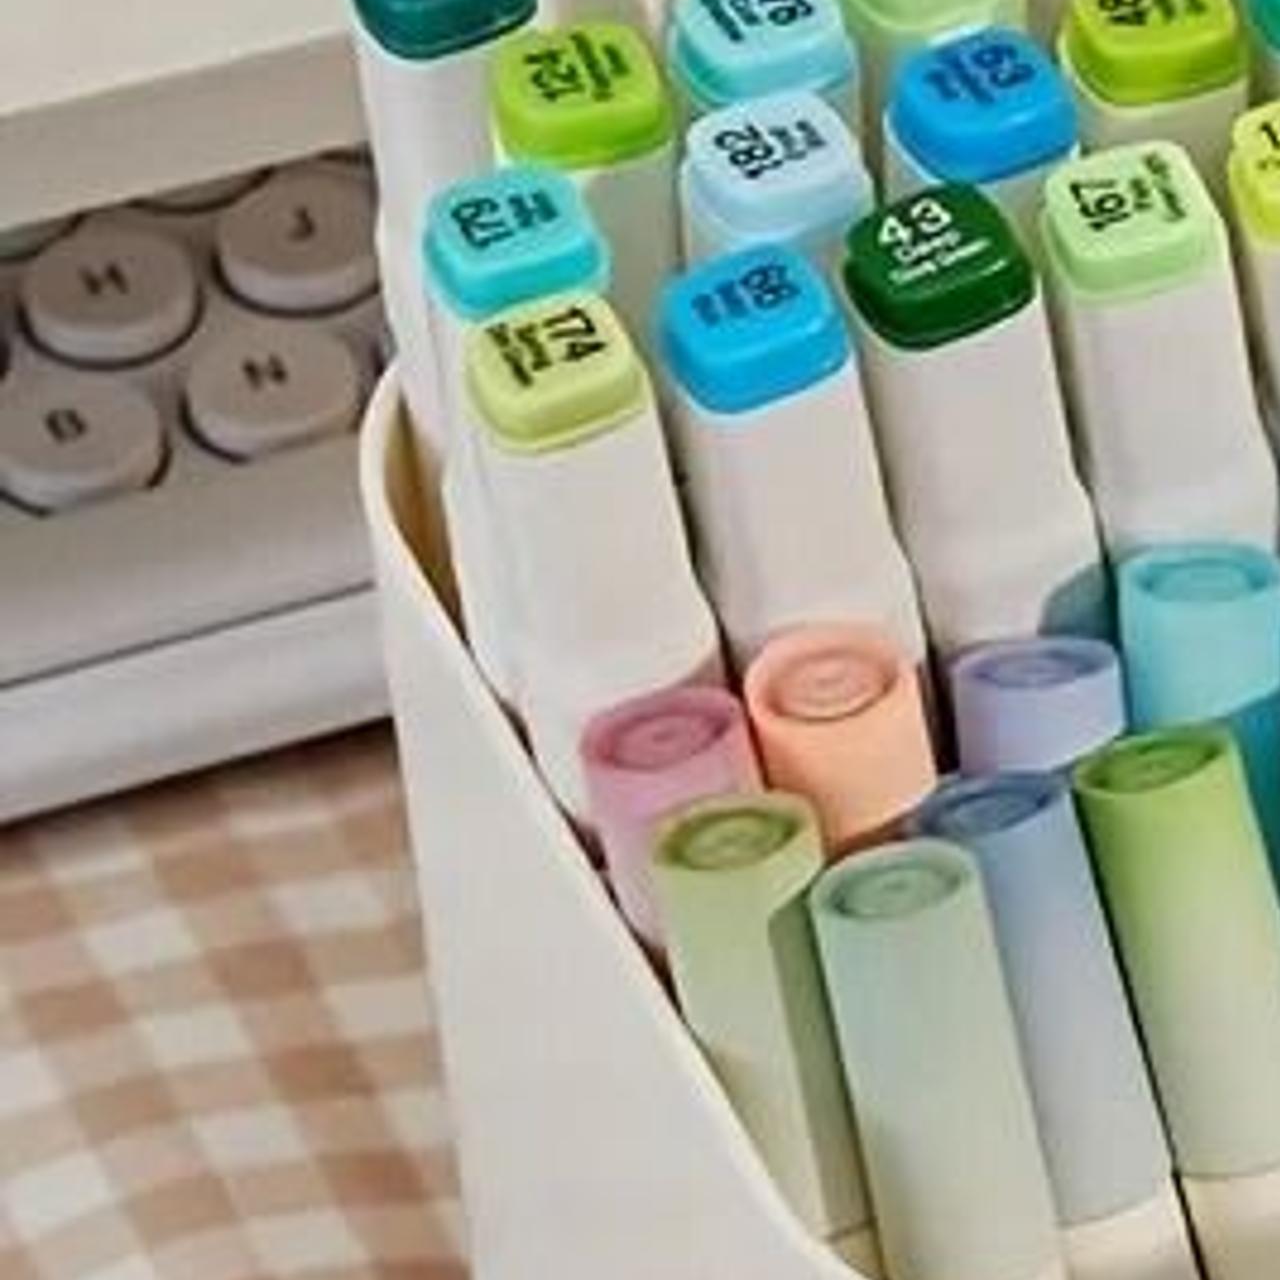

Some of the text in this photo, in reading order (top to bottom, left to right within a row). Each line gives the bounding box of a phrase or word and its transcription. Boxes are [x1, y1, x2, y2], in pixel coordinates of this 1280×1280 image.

[713, 123, 783, 180] 182
[877, 197, 952, 245] 43
[1068, 179, 1131, 232] 167
[542, 306, 606, 362] 174
